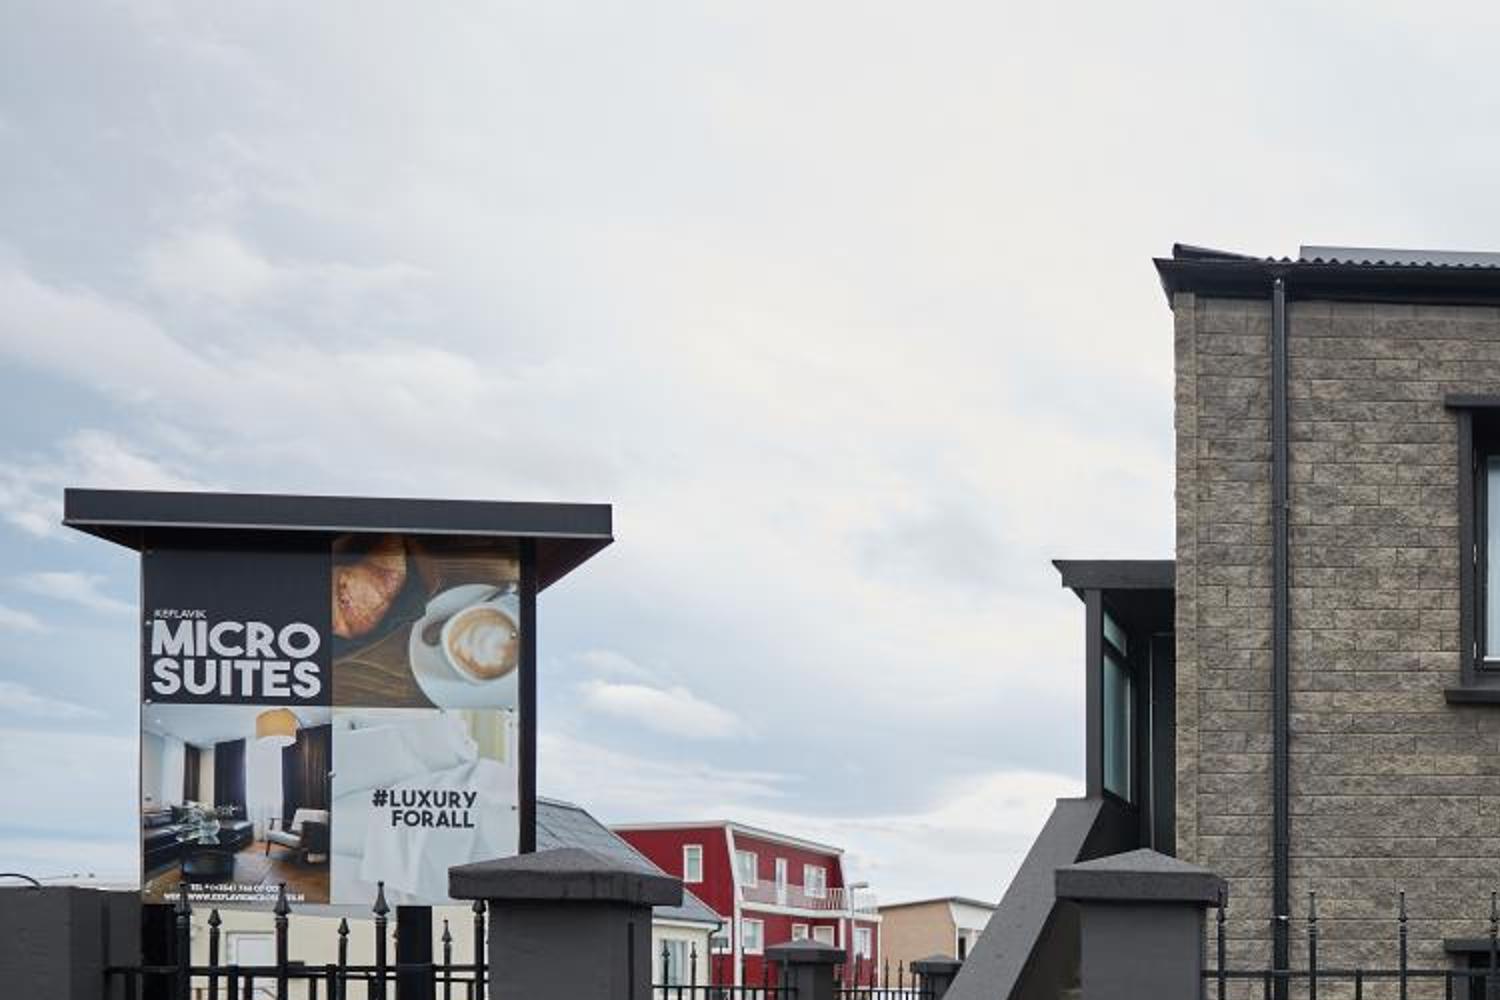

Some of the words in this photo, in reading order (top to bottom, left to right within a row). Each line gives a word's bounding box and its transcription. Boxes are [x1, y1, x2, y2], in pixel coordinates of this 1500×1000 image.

[153, 609, 207, 619] KEFLAVIK
[151, 619, 321, 659] MICRO
[151, 657, 322, 699] SUITES
[372, 789, 478, 808] #LUXURY
[391, 810, 475, 828] FORALL
